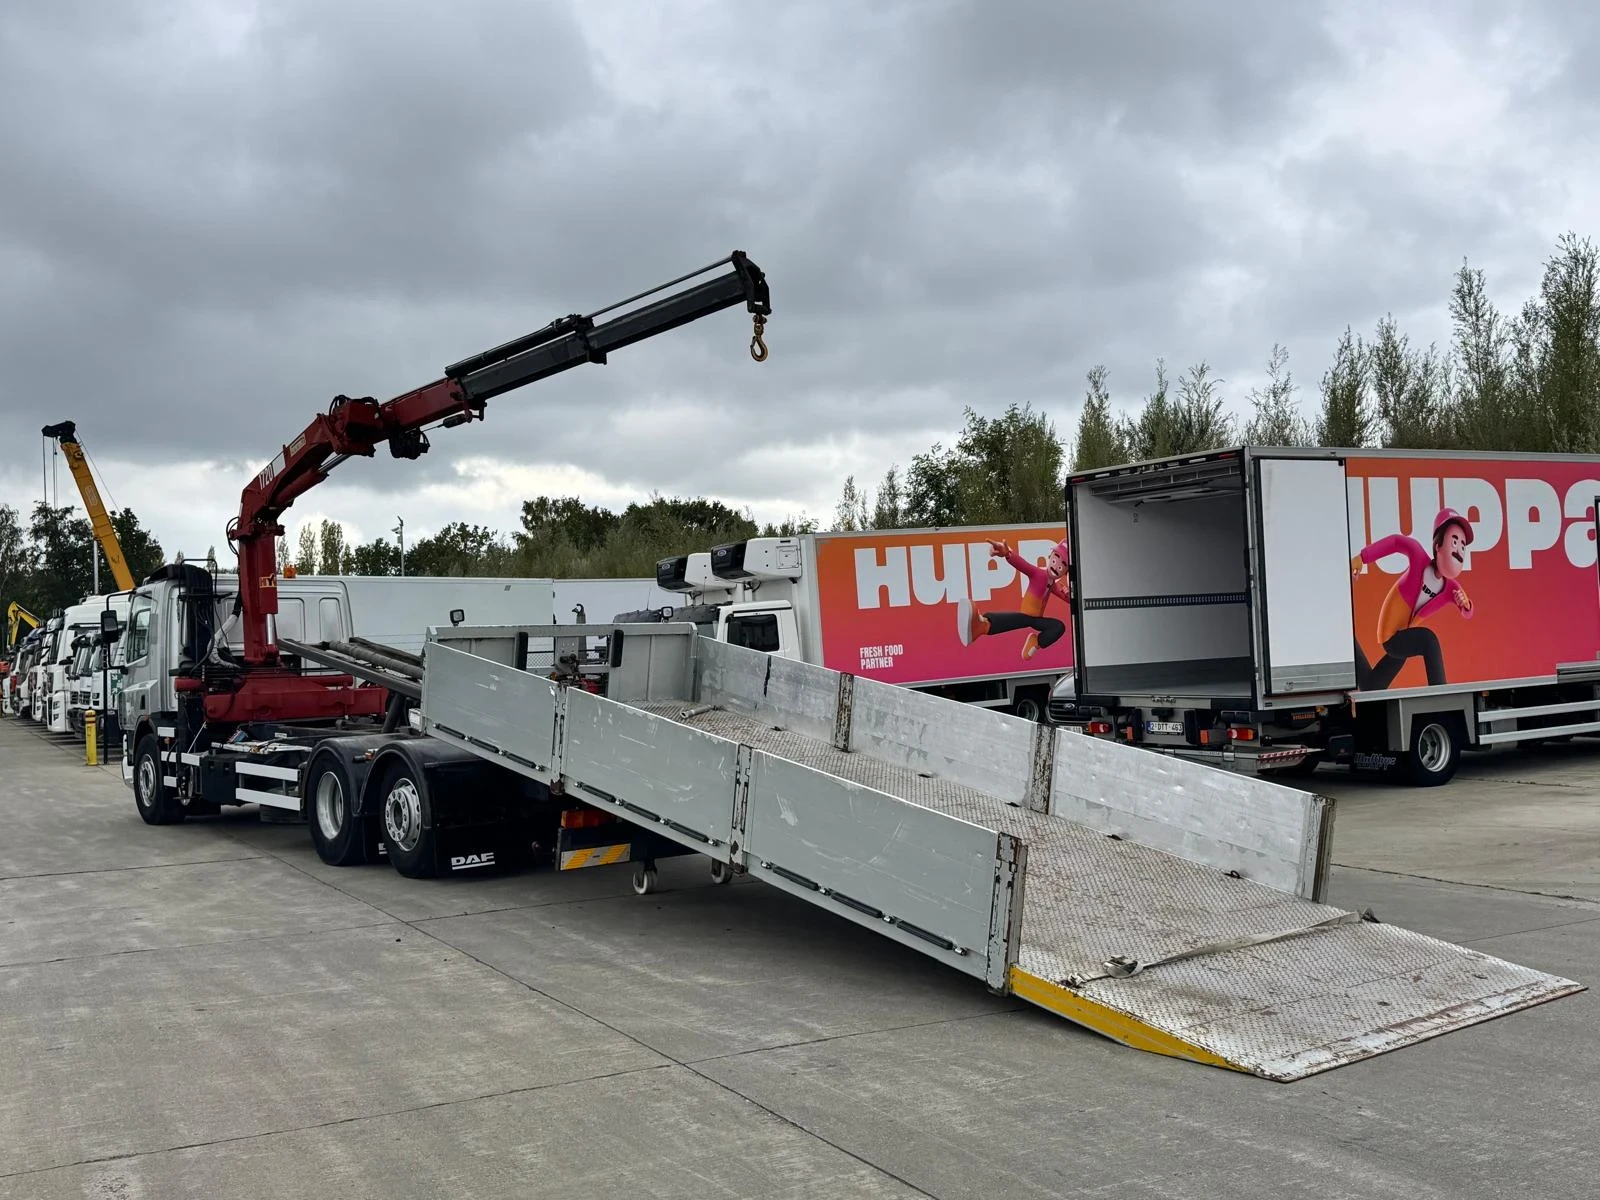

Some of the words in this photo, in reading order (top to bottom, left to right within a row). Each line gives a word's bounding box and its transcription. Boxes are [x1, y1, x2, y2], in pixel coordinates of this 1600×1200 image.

[258, 464, 274, 490] 1720
[859, 645, 883, 659] FRESH
[884, 644, 904, 656] FOOD
[860, 656, 894, 670] PARTNER
[451, 852, 495, 866] DAF
